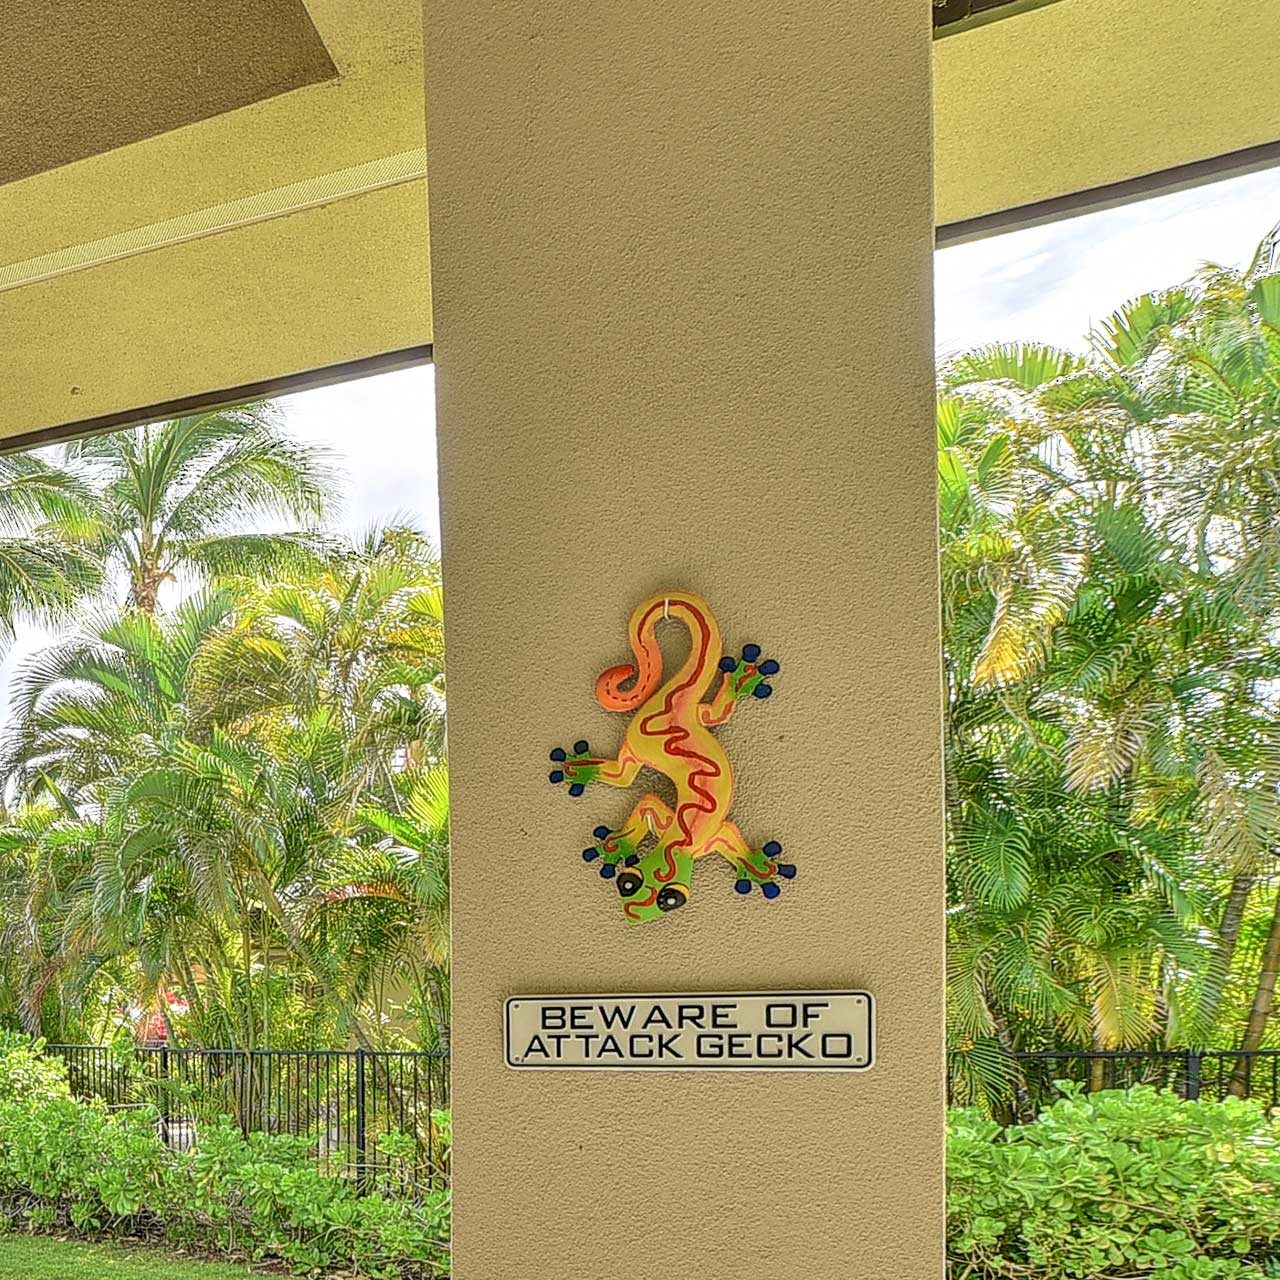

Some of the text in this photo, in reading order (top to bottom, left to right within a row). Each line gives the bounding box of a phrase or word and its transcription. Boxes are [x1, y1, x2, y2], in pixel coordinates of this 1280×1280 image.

[541, 1003, 829, 1030] BEWARE OF
[523, 1033, 852, 1059] ATTACK GECKO
